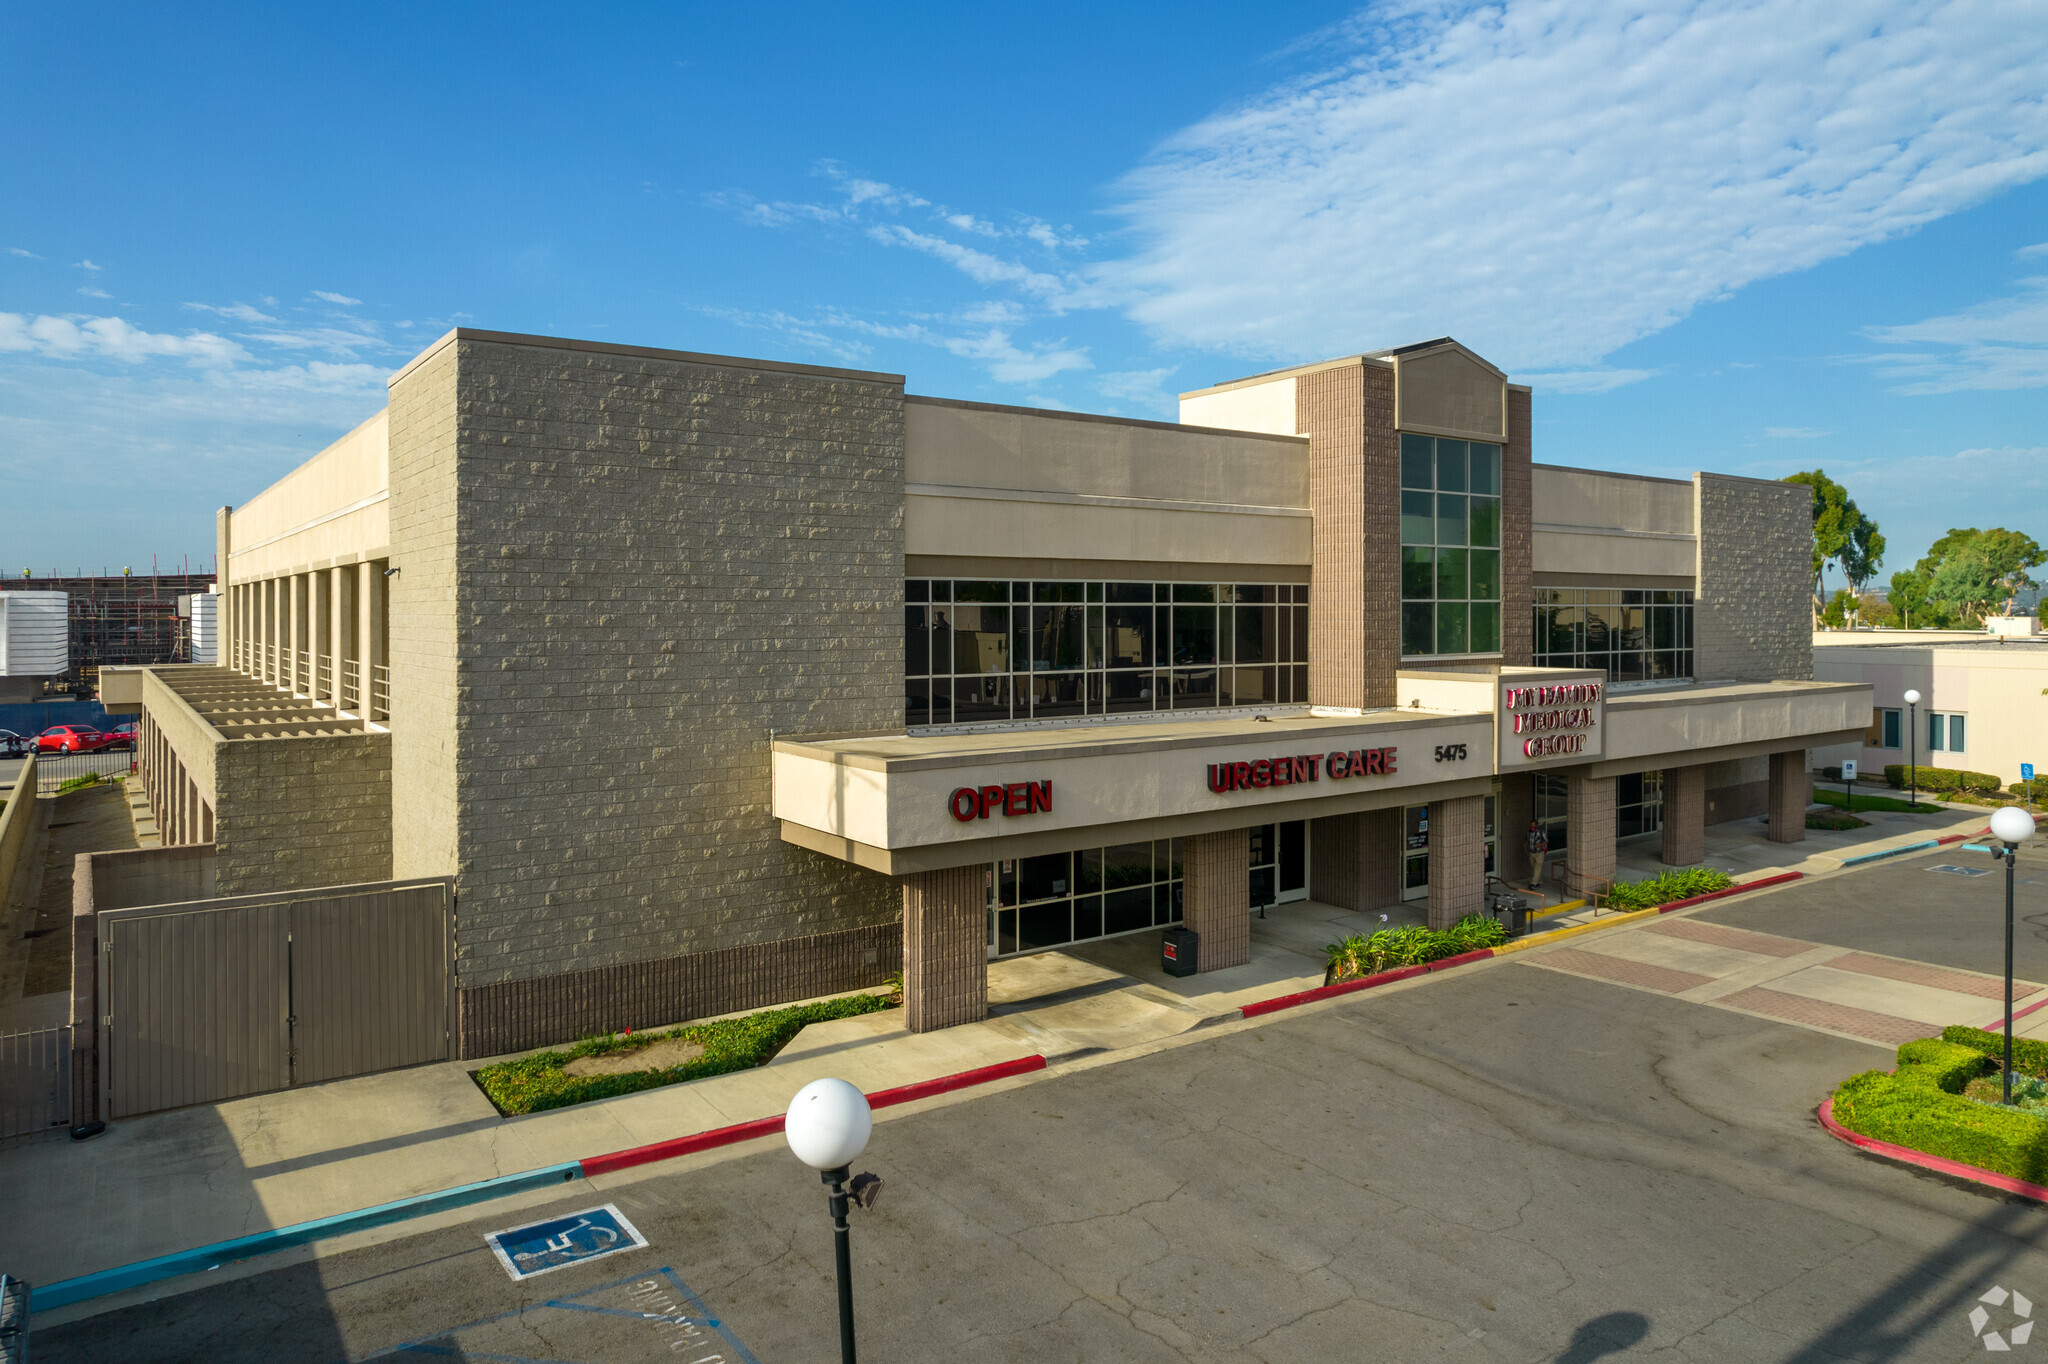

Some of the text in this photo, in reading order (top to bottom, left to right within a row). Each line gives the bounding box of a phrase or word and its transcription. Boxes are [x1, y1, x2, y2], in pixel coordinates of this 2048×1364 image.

[1507, 683, 1604, 709] MY FAMILY
[1514, 708, 1597, 734] MEDICAL
[1434, 743, 1467, 763] 5475
[1524, 733, 1587, 758] GROUP
[1207, 746, 1398, 793] URGENT CARE
[948, 779, 1053, 823] OPEN
